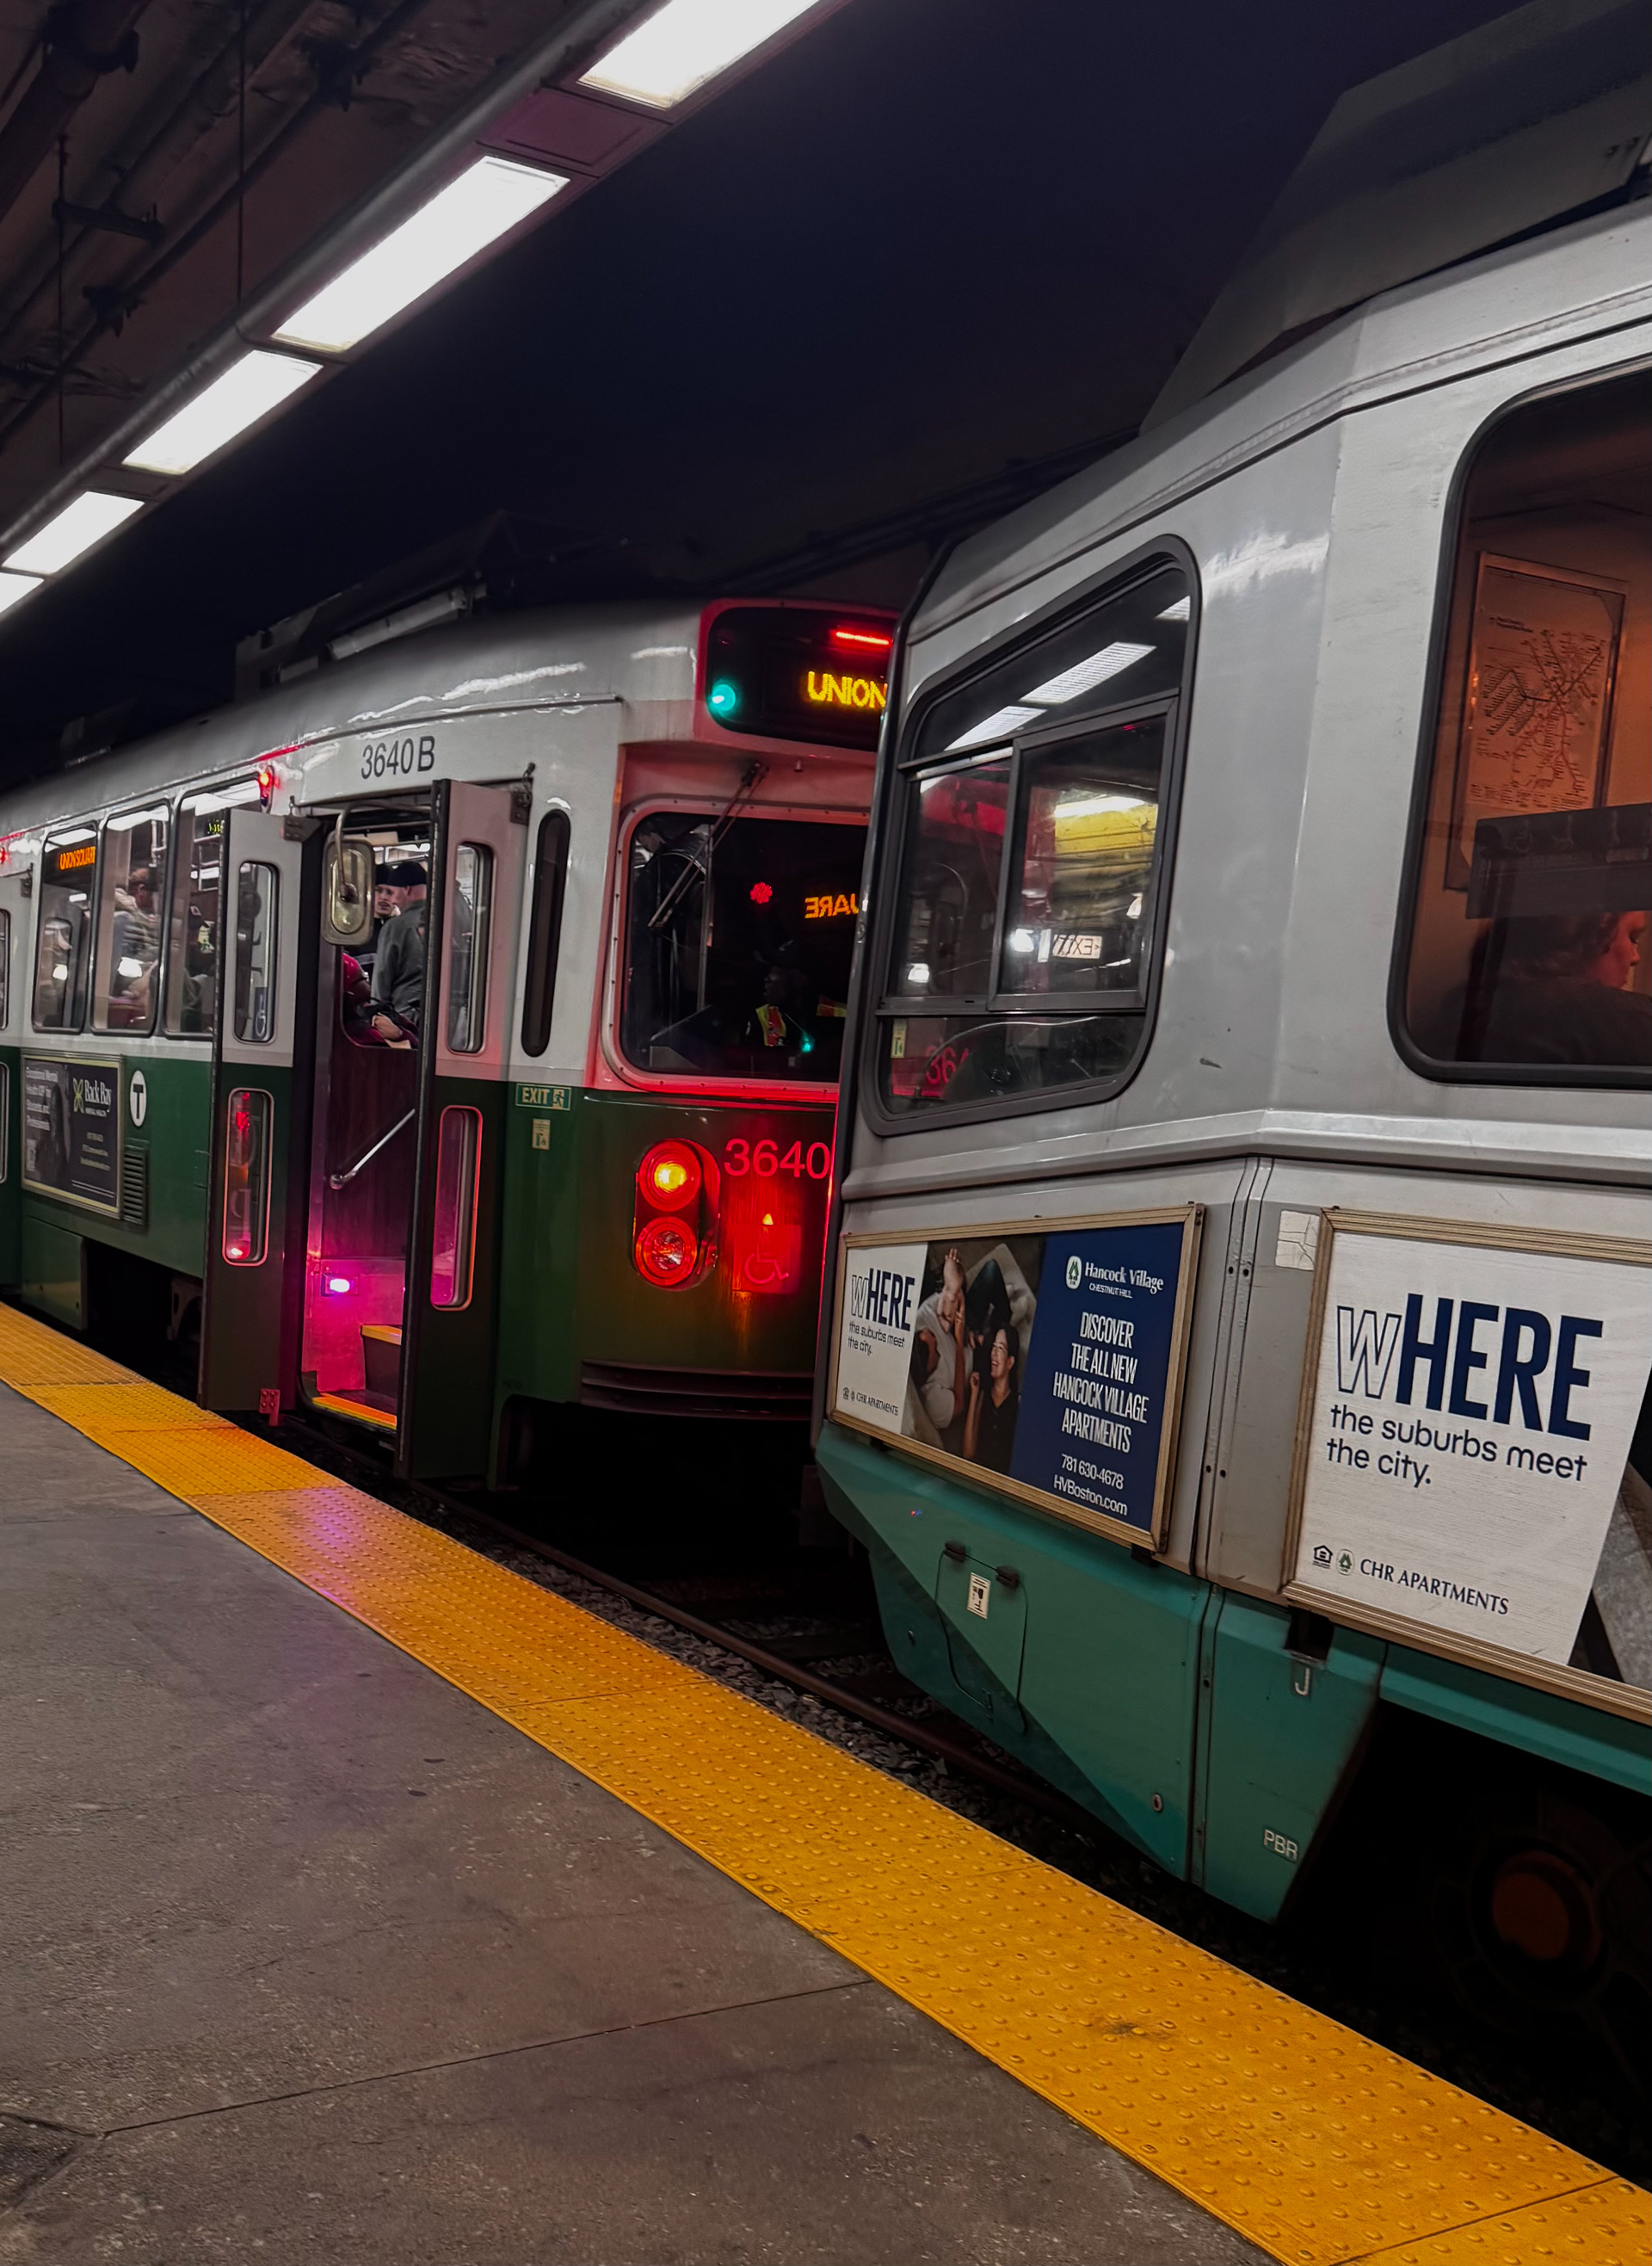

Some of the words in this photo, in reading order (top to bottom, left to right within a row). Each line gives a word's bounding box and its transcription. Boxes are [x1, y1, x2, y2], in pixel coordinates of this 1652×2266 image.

[808, 671, 887, 707] UNION
[361, 735, 435, 780] 3640B
[133, 1083, 145, 1120] T
[521, 1087, 550, 1104] EXIT
[724, 1138, 831, 1180] 3640
[1085, 1262, 1127, 1283] Hancock
[1129, 1269, 1164, 1294] Village
[848, 1337, 858, 1349] the
[849, 1321, 860, 1335] the
[861, 1325, 886, 1343] suburbs
[1080, 1312, 1134, 1349] DISCOVER
[1071, 1343, 1092, 1373] THE
[1090, 1349, 1109, 1378] ALL
[1110, 1352, 1138, 1385] NEW
[1052, 1371, 1104, 1411] HANCOCK
[1104, 1385, 1150, 1423] VILLAGE
[1061, 1407, 1132, 1454] APARTMENTS
[1330, 1404, 1374, 1435] the
[1381, 1419, 1498, 1462] suburbs
[1506, 1445, 1588, 1482] meet
[1061, 1454, 1077, 1473] 781
[1078, 1460, 1125, 1490] 630-4678
[1327, 1437, 1370, 1469] the
[1378, 1450, 1432, 1489] city.
[1053, 1474, 1128, 1516] HVBoston.com
[1359, 1559, 1395, 1583] CHR
[1396, 1570, 1509, 1615] APARTMENTS
[1263, 1829, 1298, 1862] PBR
